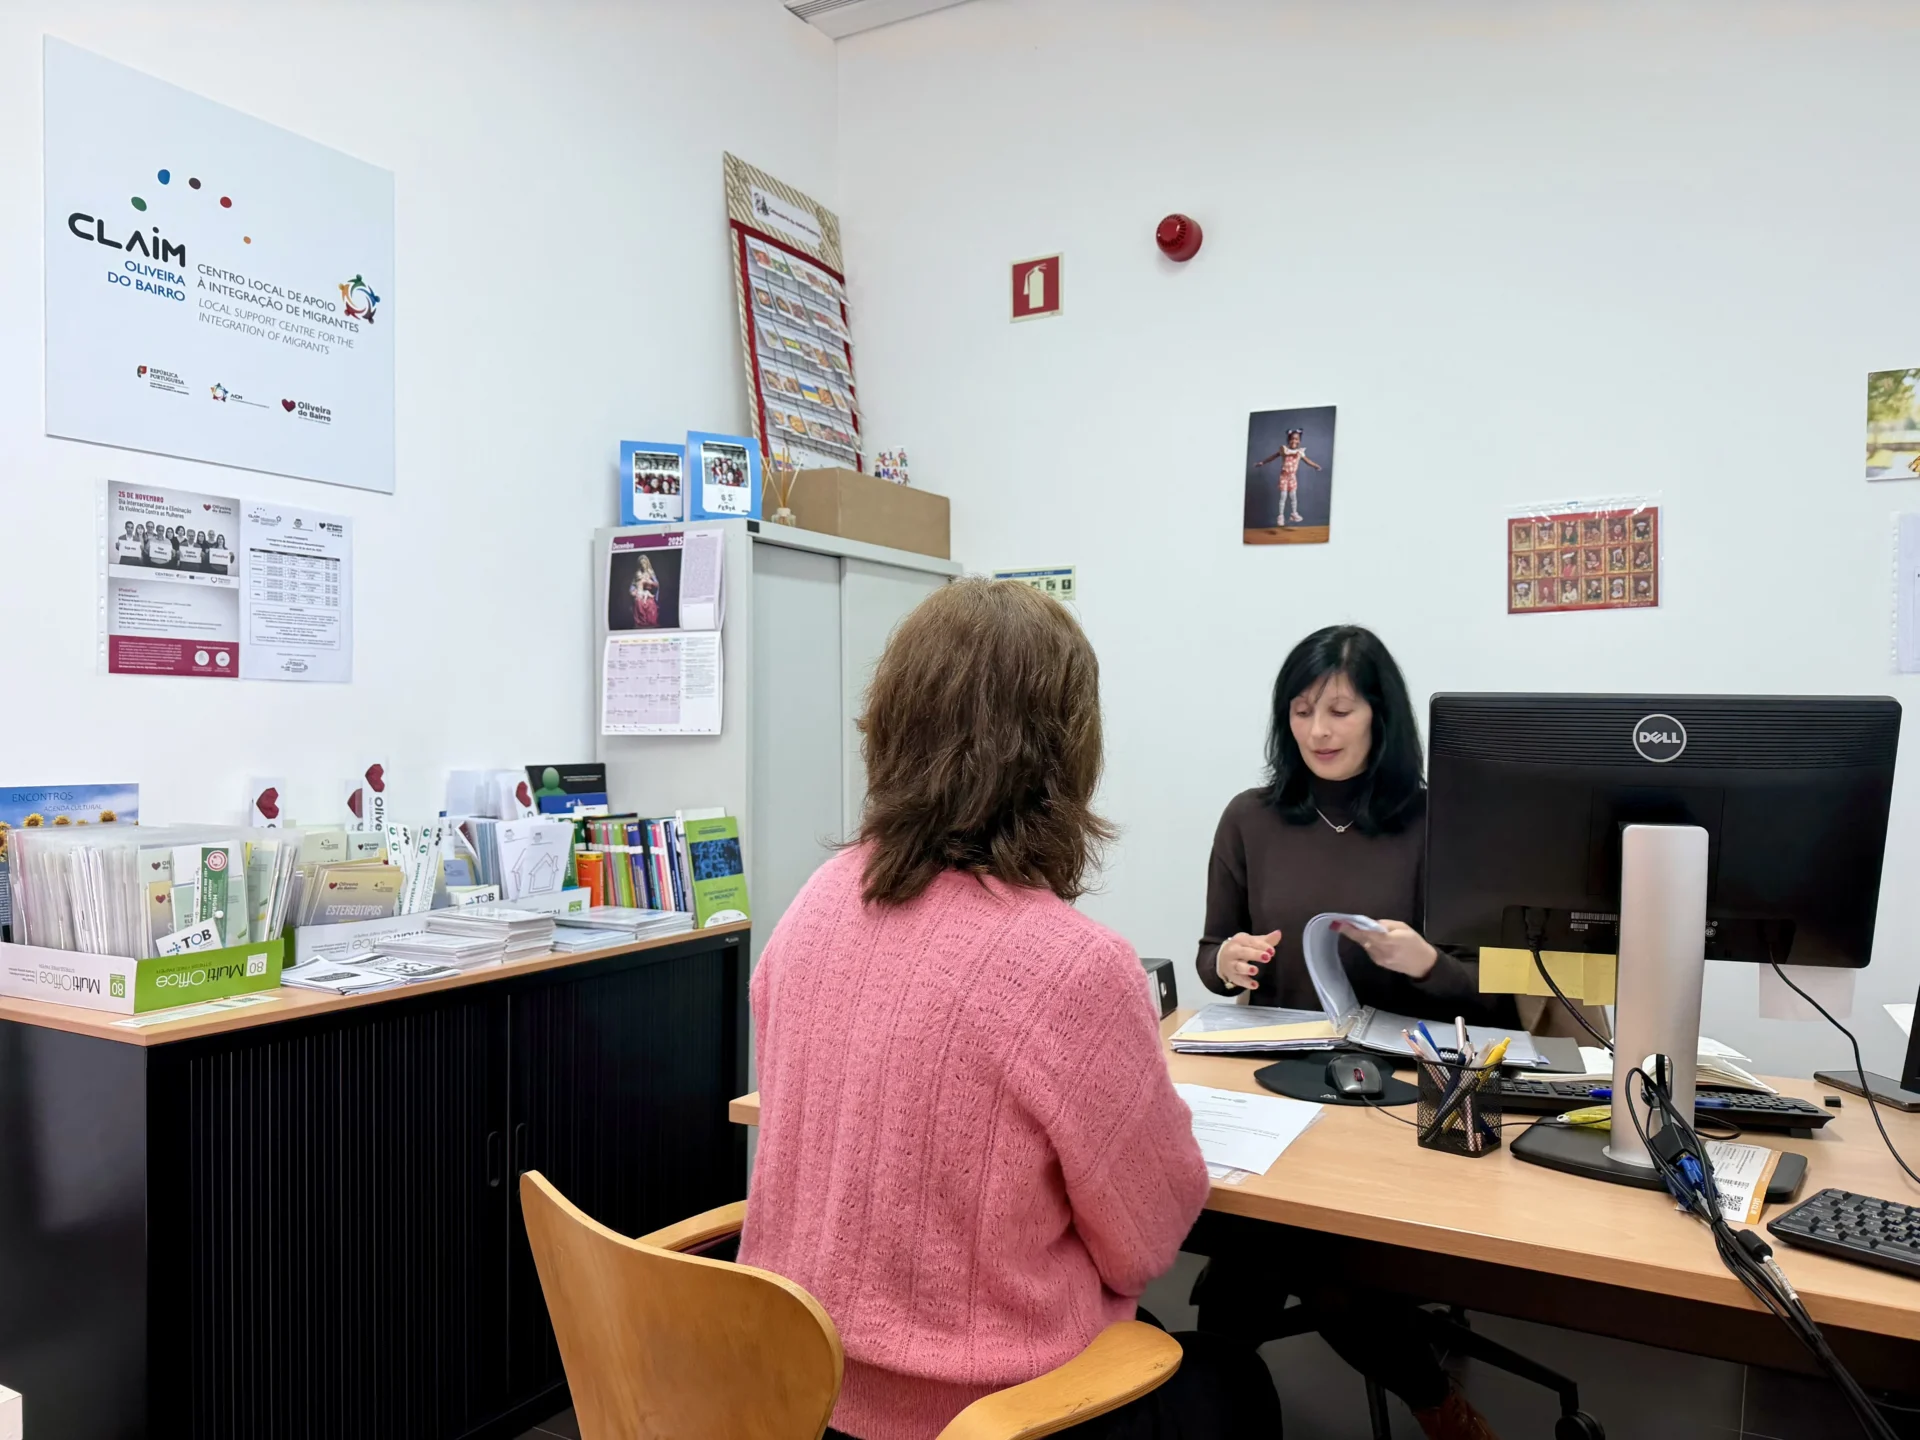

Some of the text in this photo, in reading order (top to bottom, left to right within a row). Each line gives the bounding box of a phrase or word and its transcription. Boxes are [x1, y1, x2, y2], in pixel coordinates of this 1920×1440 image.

[124, 260, 186, 286] OLIVEIRA
[108, 271, 186, 301] DO BAIRRO
[197, 263, 336, 312] CENTRO LOCAL DE APOIO
[197, 276, 360, 333] À INTEGRAÇÃO DE MIGRANTES
[199, 298, 354, 349] LOCAL SUPPORT CENTRE FOR THE
[199, 312, 330, 355] INTEGRATION OF MIGRANTS
[149, 367, 179, 379] REPÚBLICA
[149, 373, 185, 385] PORTUGUESA
[297, 401, 331, 416] Oliveira
[297, 409, 308, 417] do
[309, 411, 331, 422] Bairro
[126, 491, 134, 500] DE
[135, 493, 164, 504] NOVEMBRO
[668, 536, 683, 546] 2025
[1639, 731, 1681, 744] DELL
[12, 791, 74, 803] ENCONTROS
[475, 892, 495, 904] TOB
[180, 929, 212, 949] TOB
[249, 961, 264, 974] 80
[111, 982, 124, 996] 80
